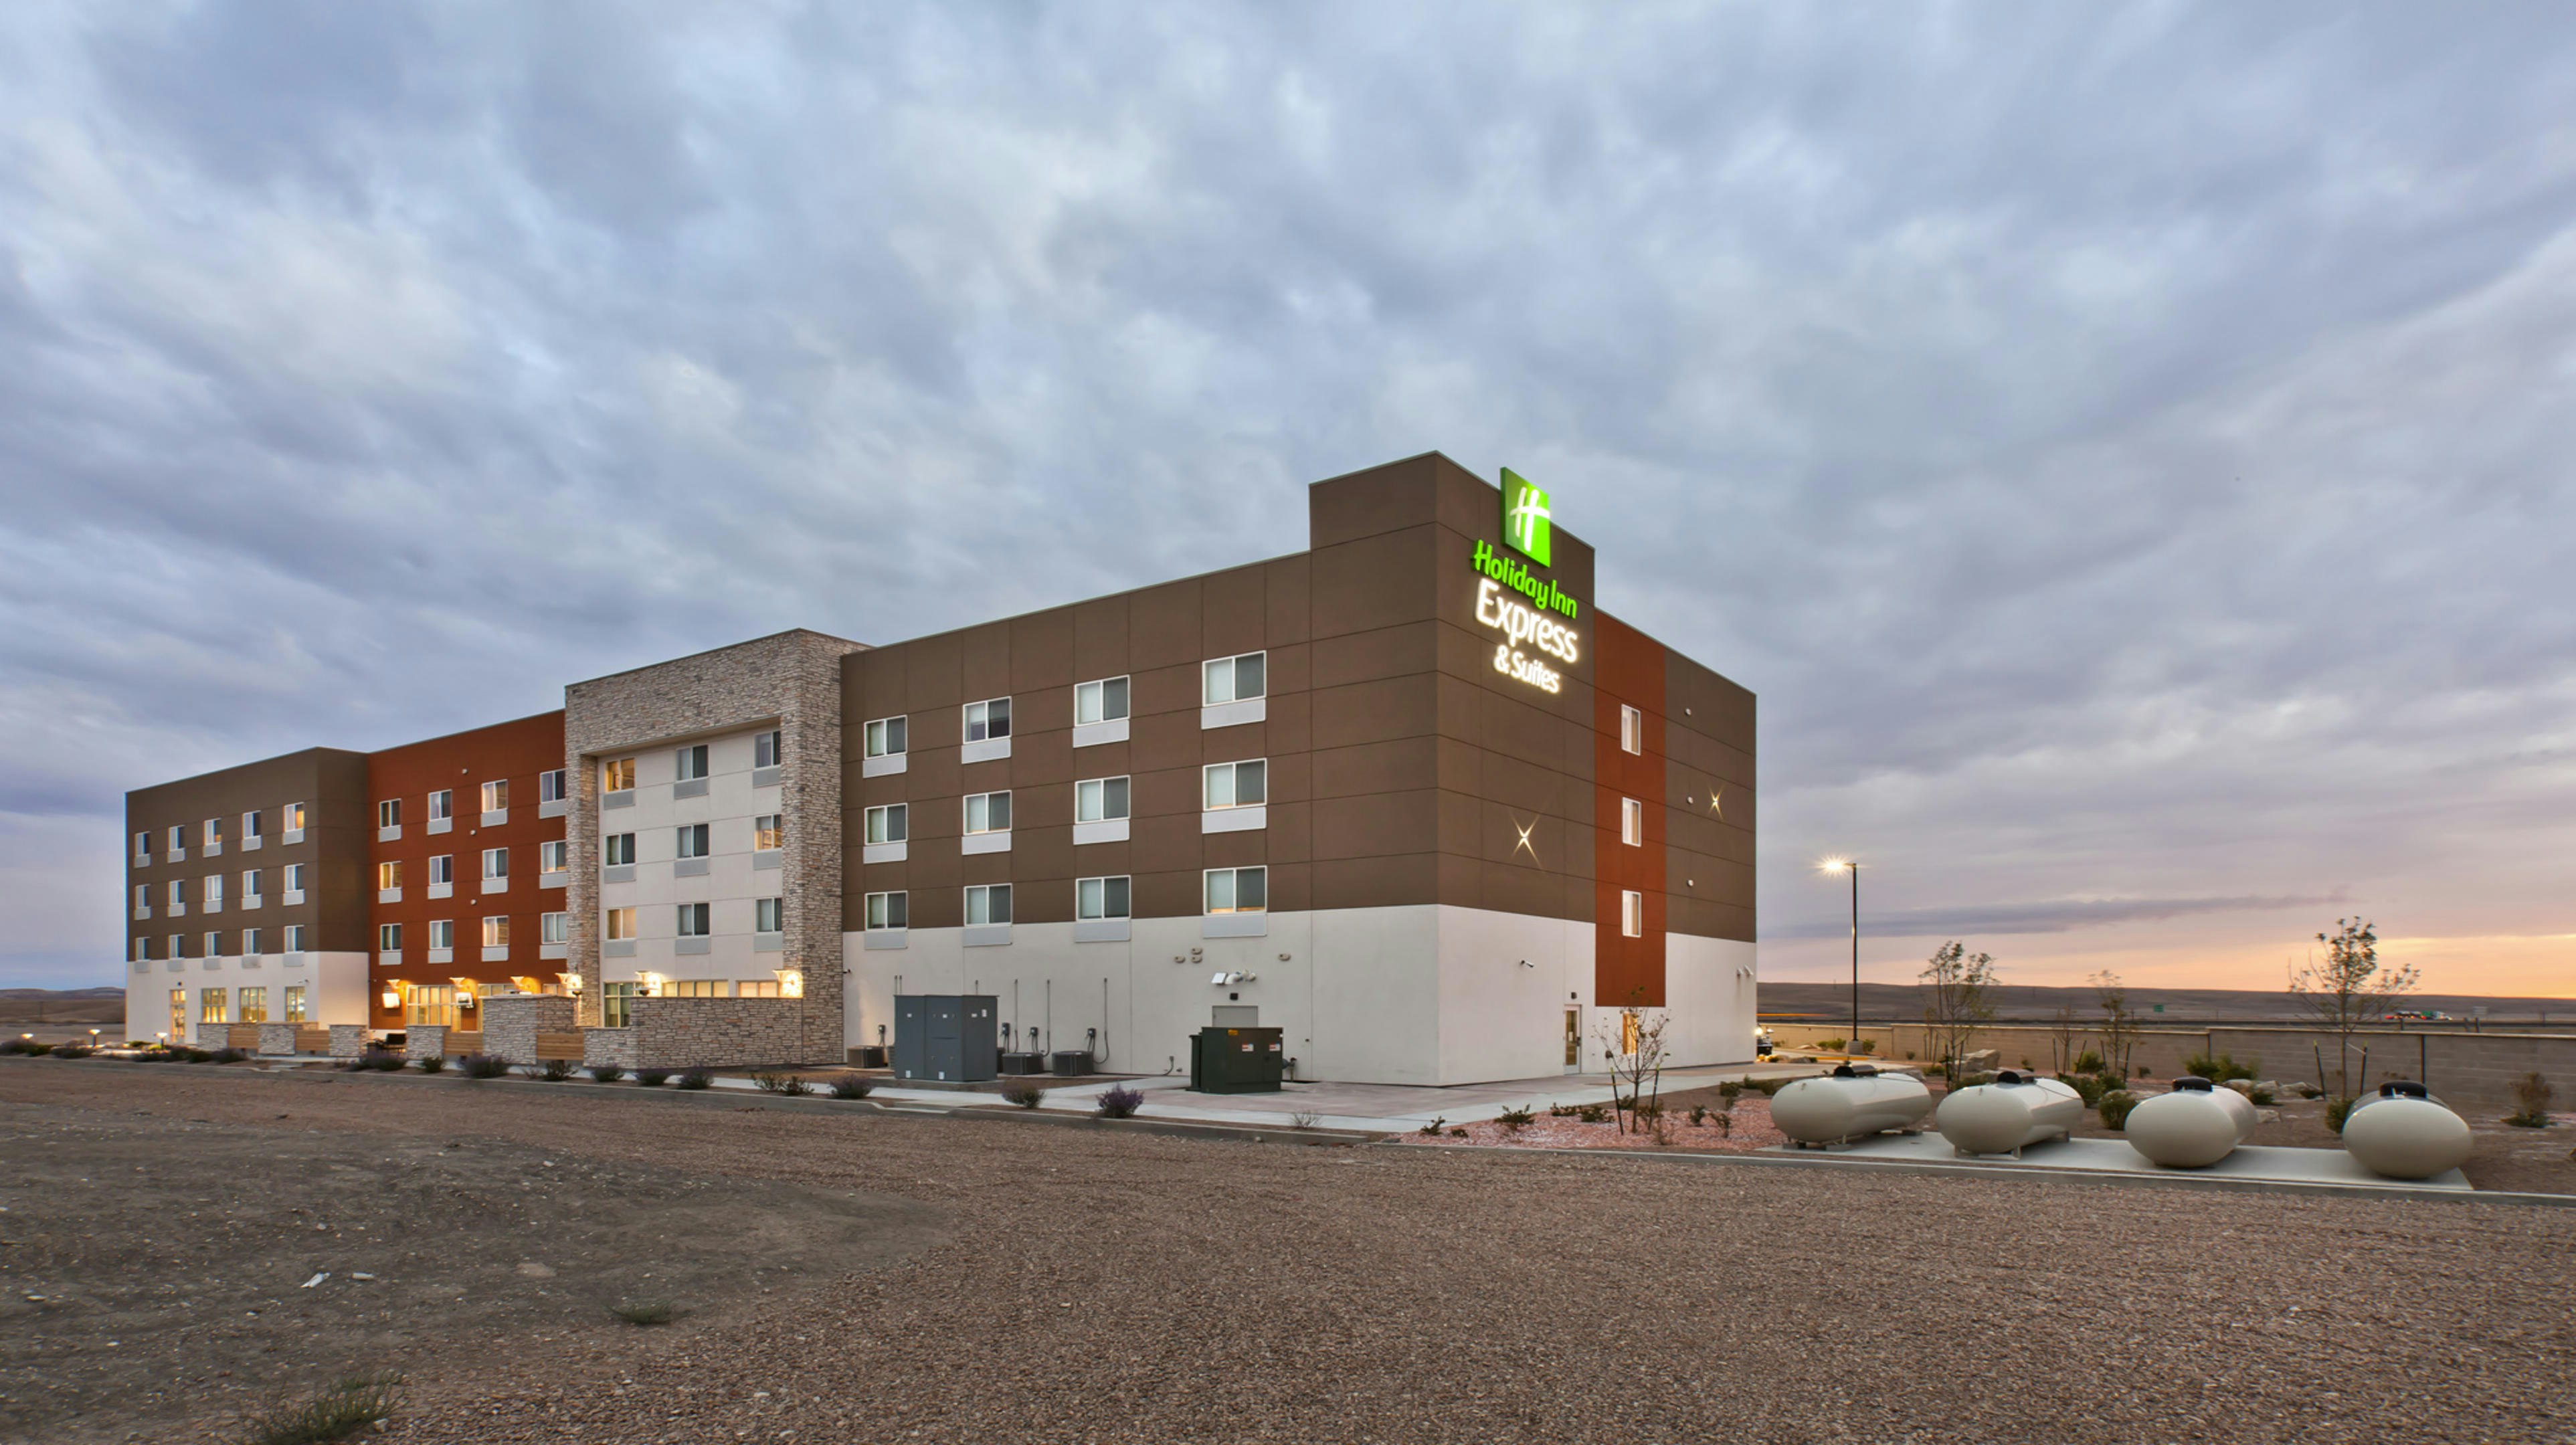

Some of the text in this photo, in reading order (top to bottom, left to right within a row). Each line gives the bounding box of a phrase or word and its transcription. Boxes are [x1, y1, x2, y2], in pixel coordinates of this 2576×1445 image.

[1509, 487, 1550, 551] H
[1474, 539, 1577, 619] Holiday Inn
[1476, 578, 1578, 662] Express
[1493, 644, 1560, 694] & Suites
